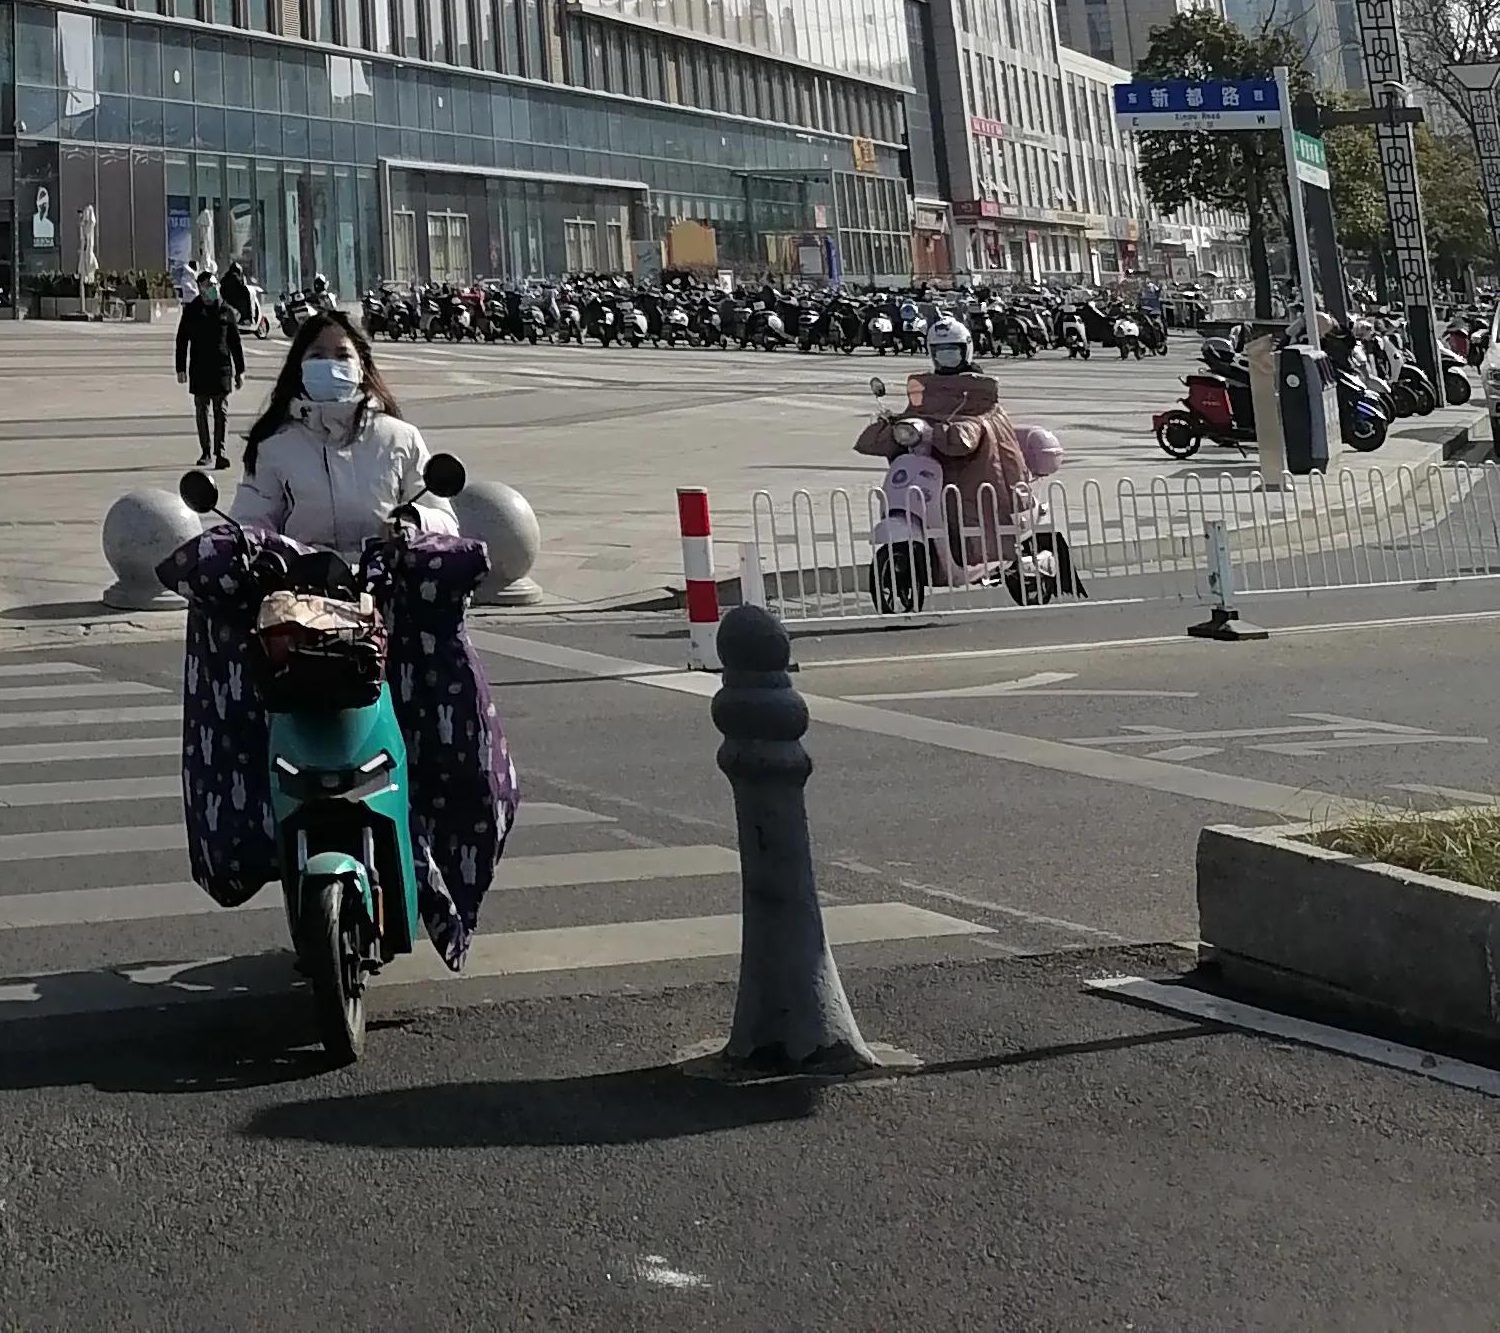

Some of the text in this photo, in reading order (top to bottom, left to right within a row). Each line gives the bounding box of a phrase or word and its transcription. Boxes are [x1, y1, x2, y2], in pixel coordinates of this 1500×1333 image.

[1151, 87, 1240, 108] 新都路
[1132, 117, 1140, 126] E
[1256, 115, 1266, 125] W
